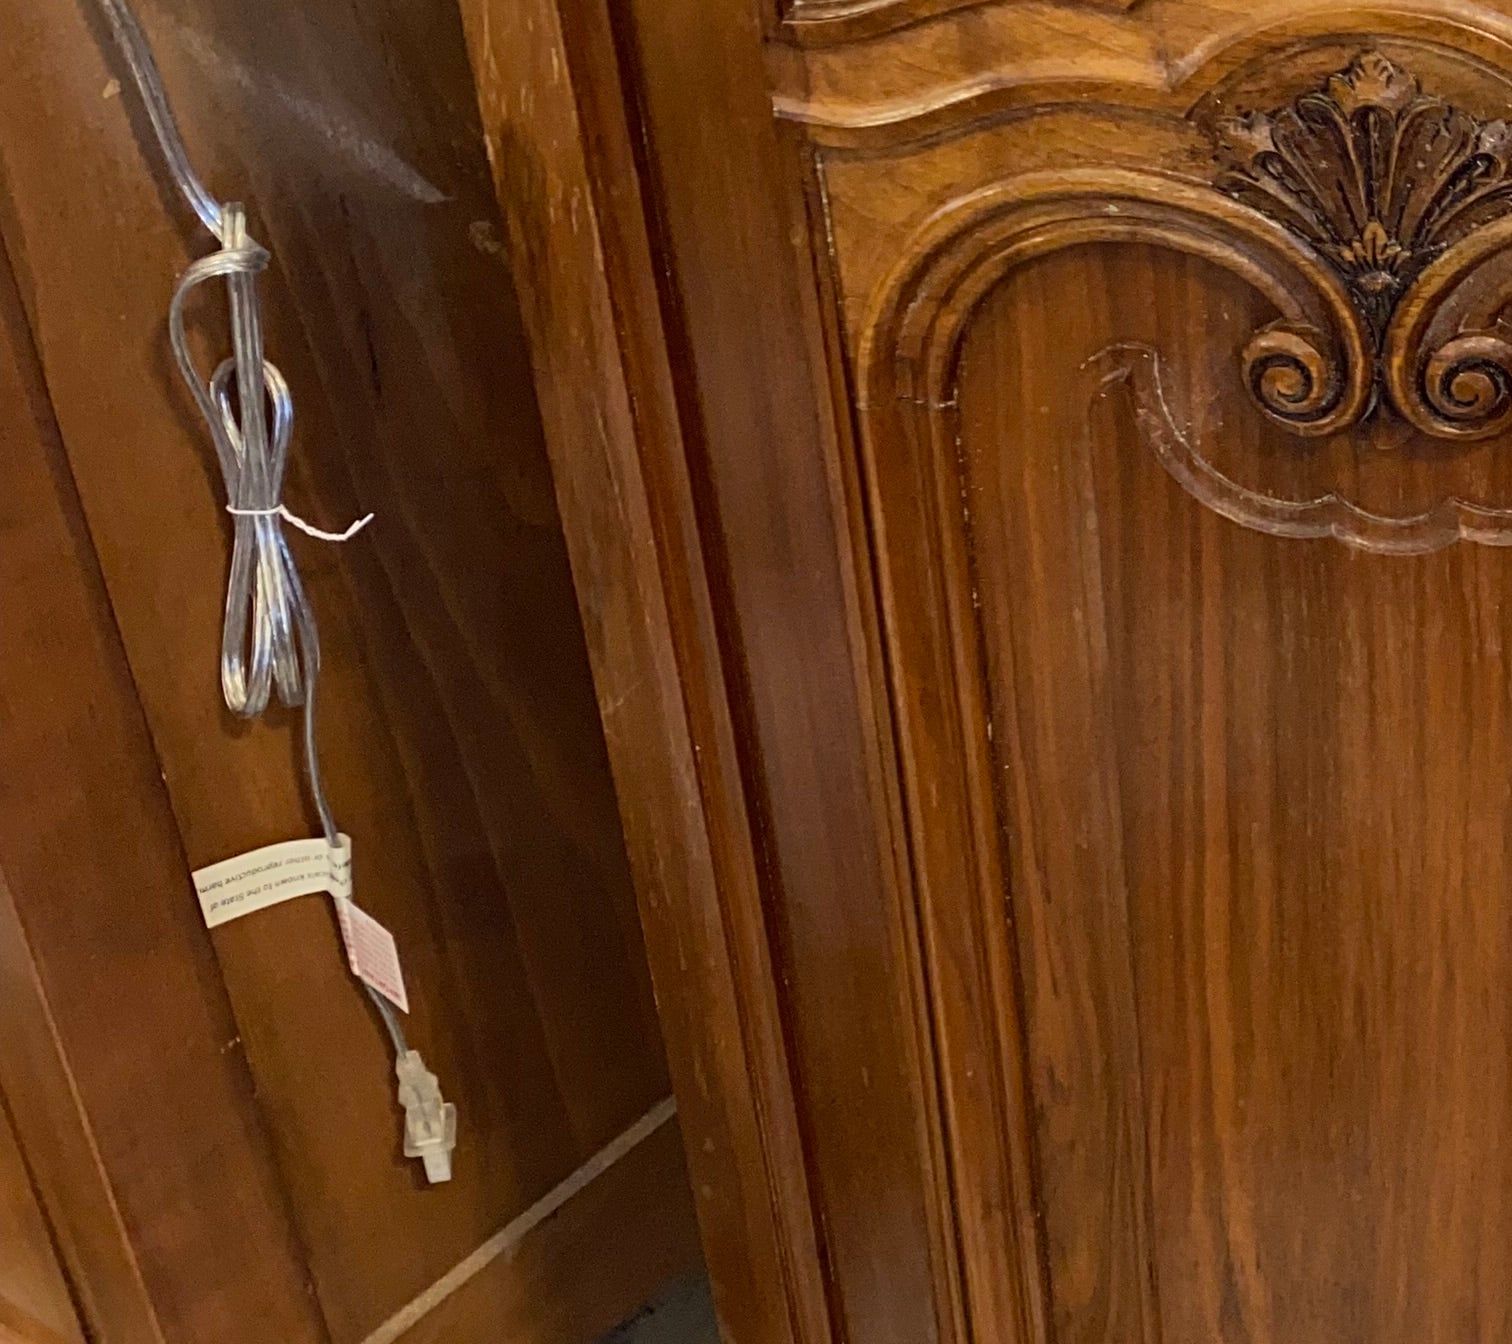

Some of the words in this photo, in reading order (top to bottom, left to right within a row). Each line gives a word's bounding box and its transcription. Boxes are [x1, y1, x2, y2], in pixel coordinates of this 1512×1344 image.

[225, 861, 283, 884] reproductive
[246, 887, 262, 897] the
[221, 894, 244, 907] State
